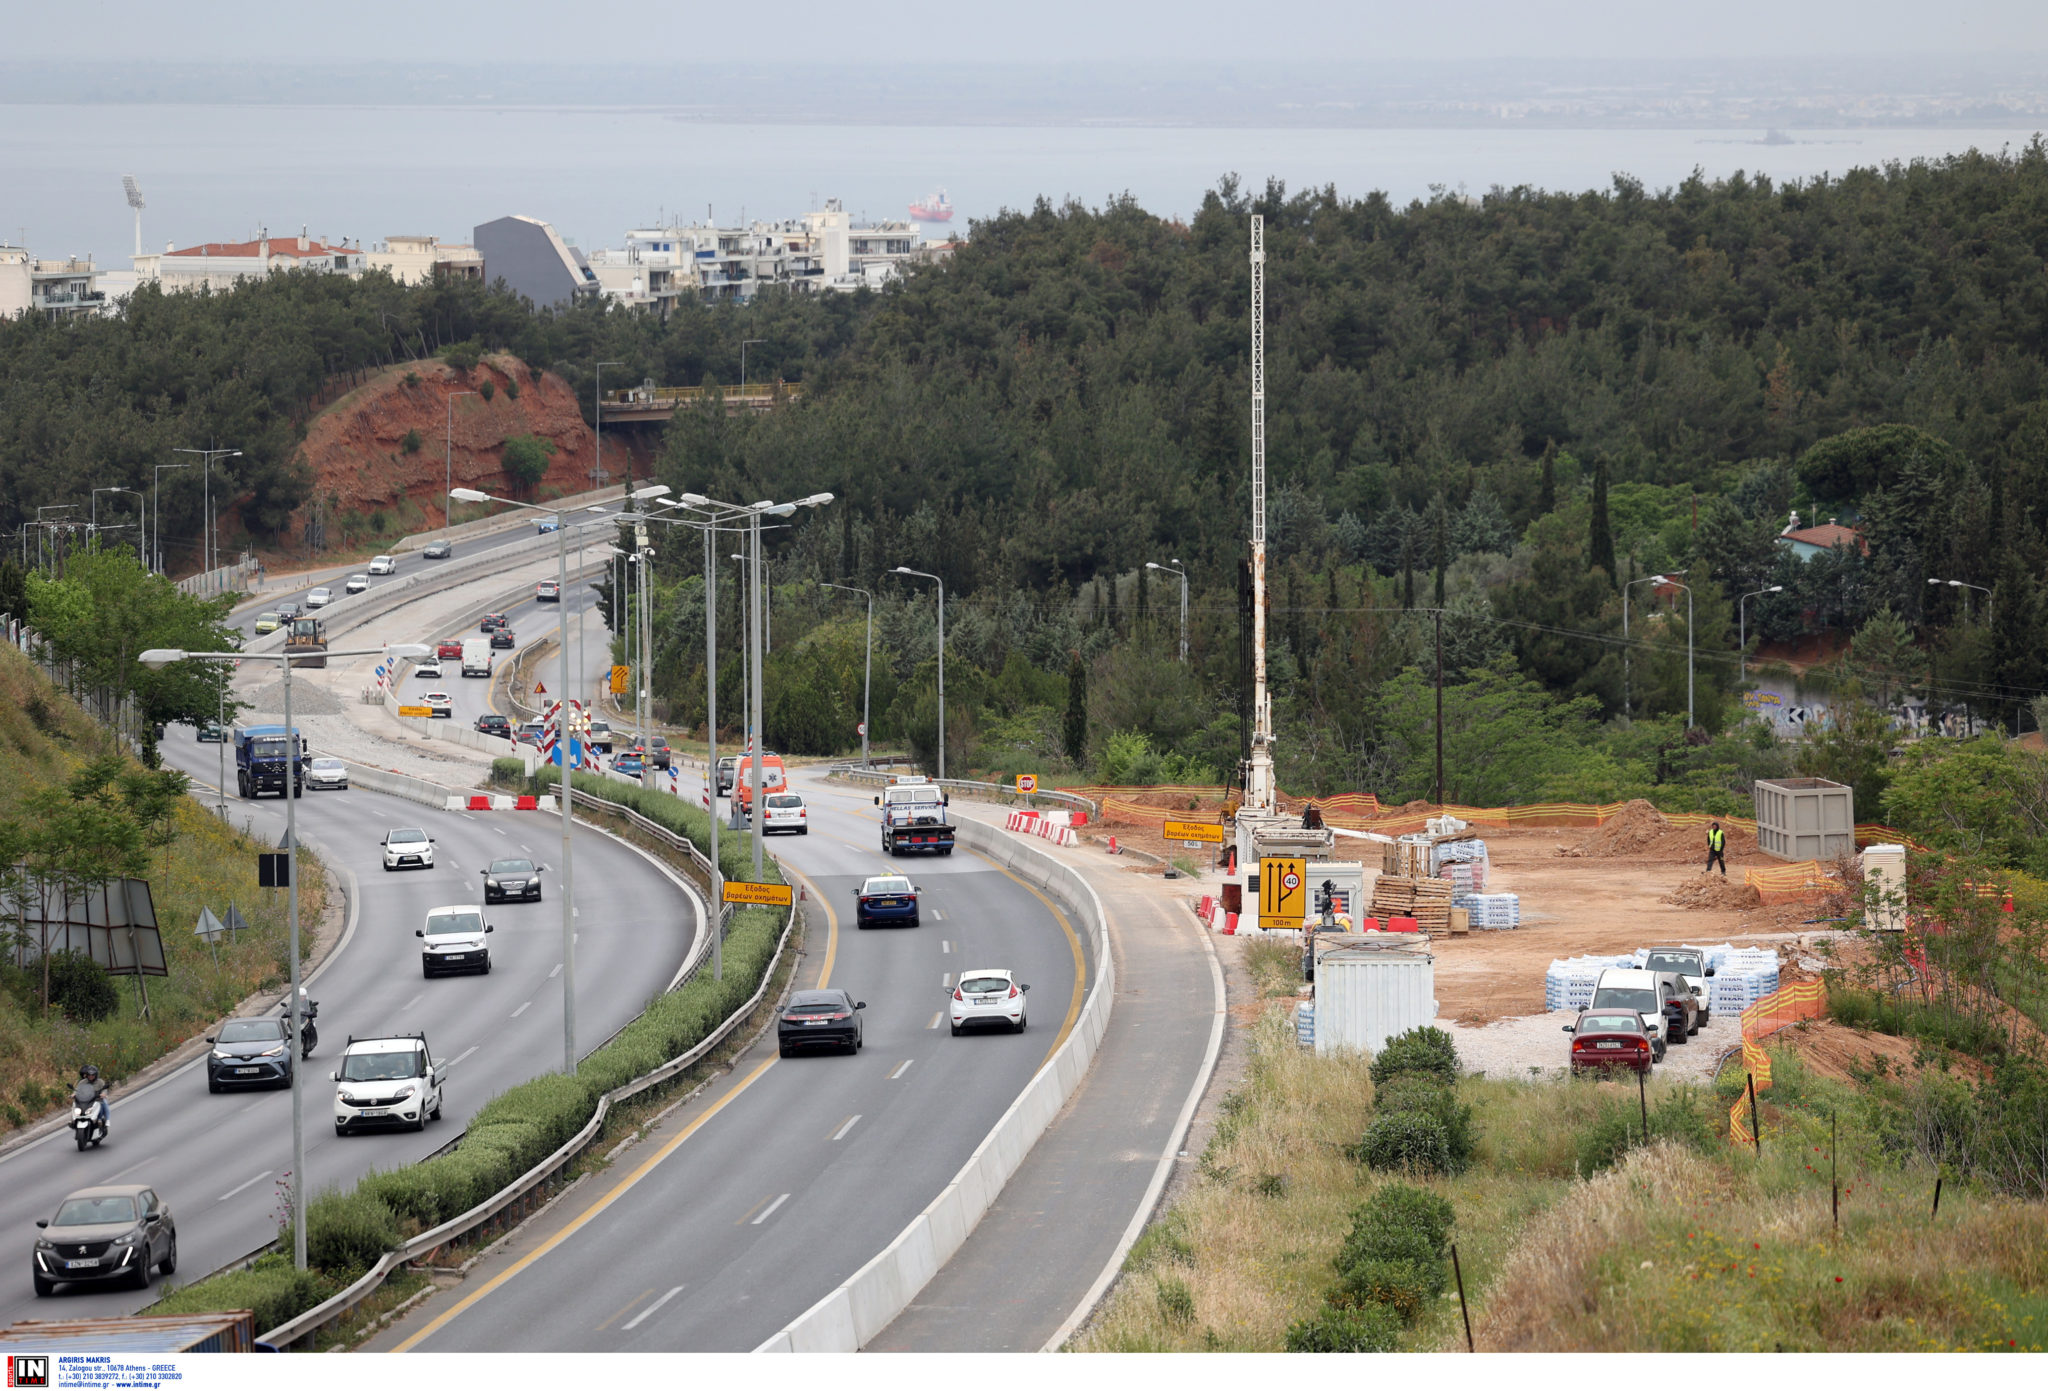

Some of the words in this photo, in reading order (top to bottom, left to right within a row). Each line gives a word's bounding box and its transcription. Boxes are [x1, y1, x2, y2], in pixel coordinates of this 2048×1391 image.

[1020, 780, 1034, 788] STOP
[1286, 877, 1297, 885] 40
[745, 884, 770, 894] Έξοδος
[726, 892, 752, 900] βαρέων
[754, 894, 788, 902] οχημάτων
